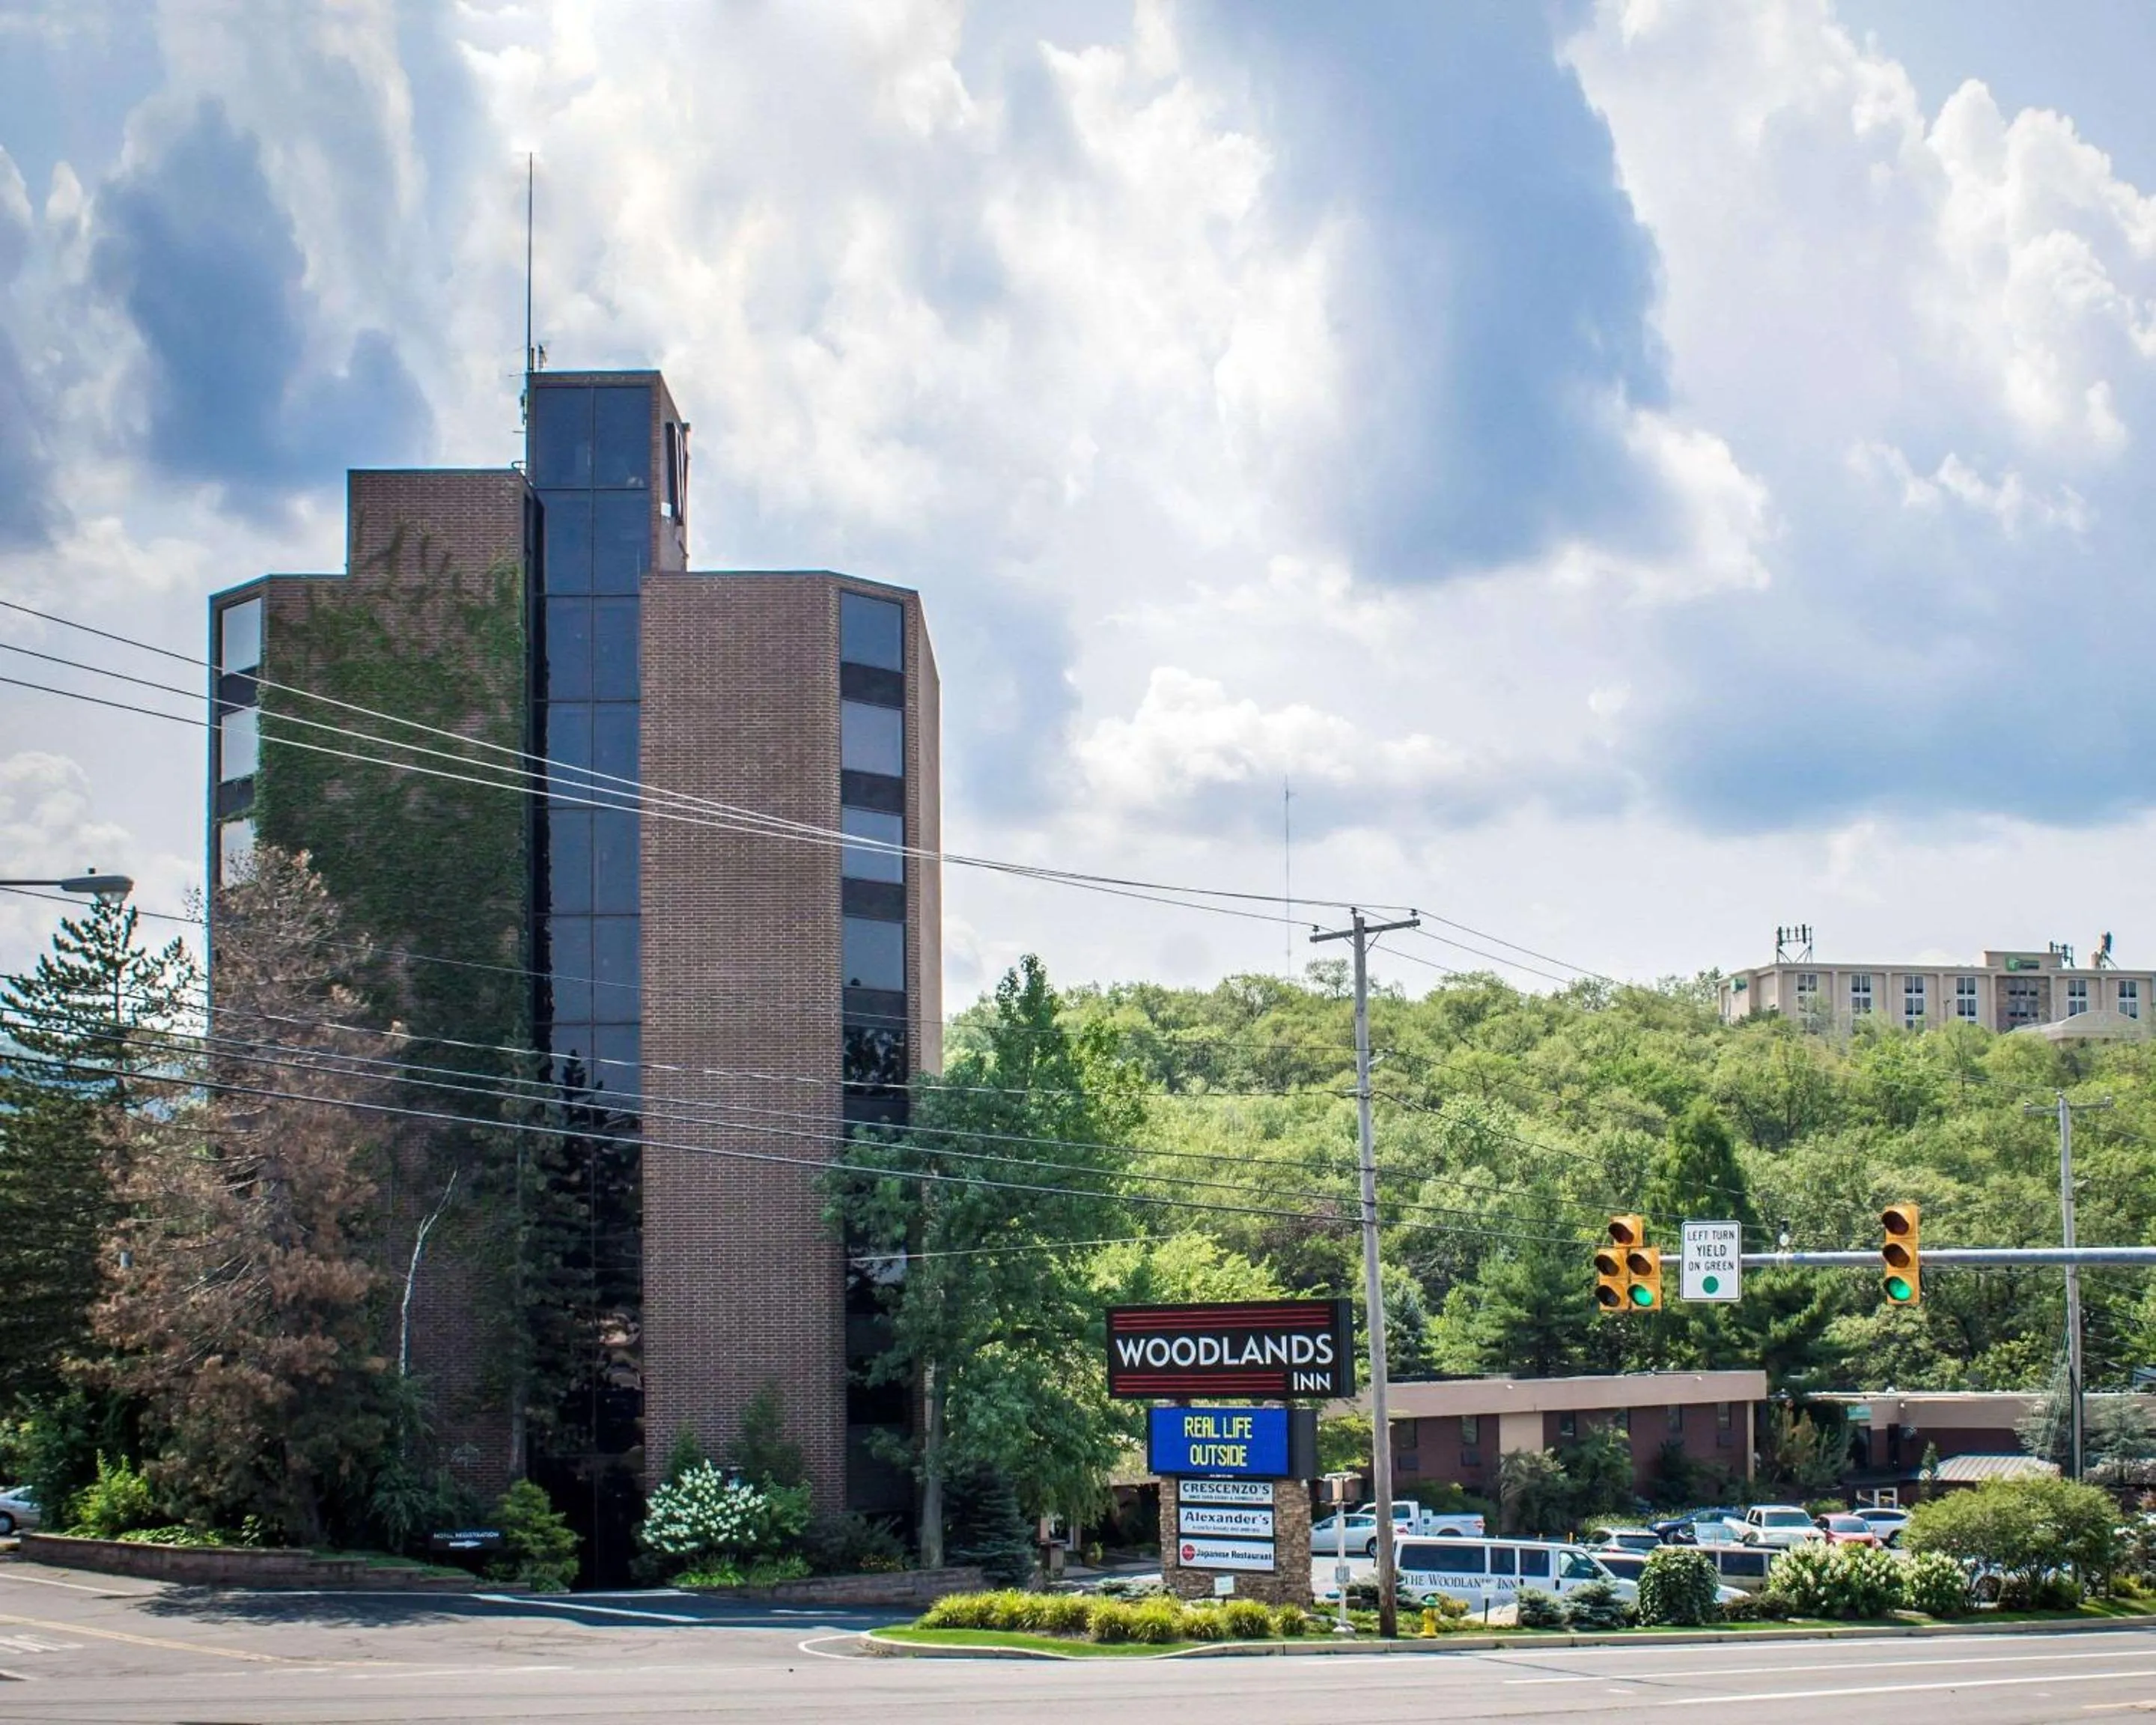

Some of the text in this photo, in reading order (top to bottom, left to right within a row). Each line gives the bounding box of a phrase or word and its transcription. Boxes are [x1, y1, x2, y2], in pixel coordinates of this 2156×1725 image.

[1687, 1230, 1735, 1241] LEFT TURN
[1696, 1244, 1726, 1257] YIELD
[1688, 1261, 1735, 1271] ON GREEN
[1116, 1333, 1333, 1368] WOODLANDS
[1293, 1372, 1331, 1391] INN
[1184, 1417, 1252, 1439] REAL LIFE
[1190, 1444, 1248, 1467] OUTSIDE
[1183, 1482, 1270, 1494] CRESCENZO'S
[1185, 1512, 1270, 1525] Alexander's
[1196, 1549, 1229, 1559] Japanese
[1231, 1551, 1273, 1560] Restaurant
[1403, 1575, 1424, 1586] THE
[1497, 1577, 1517, 1589] INN
